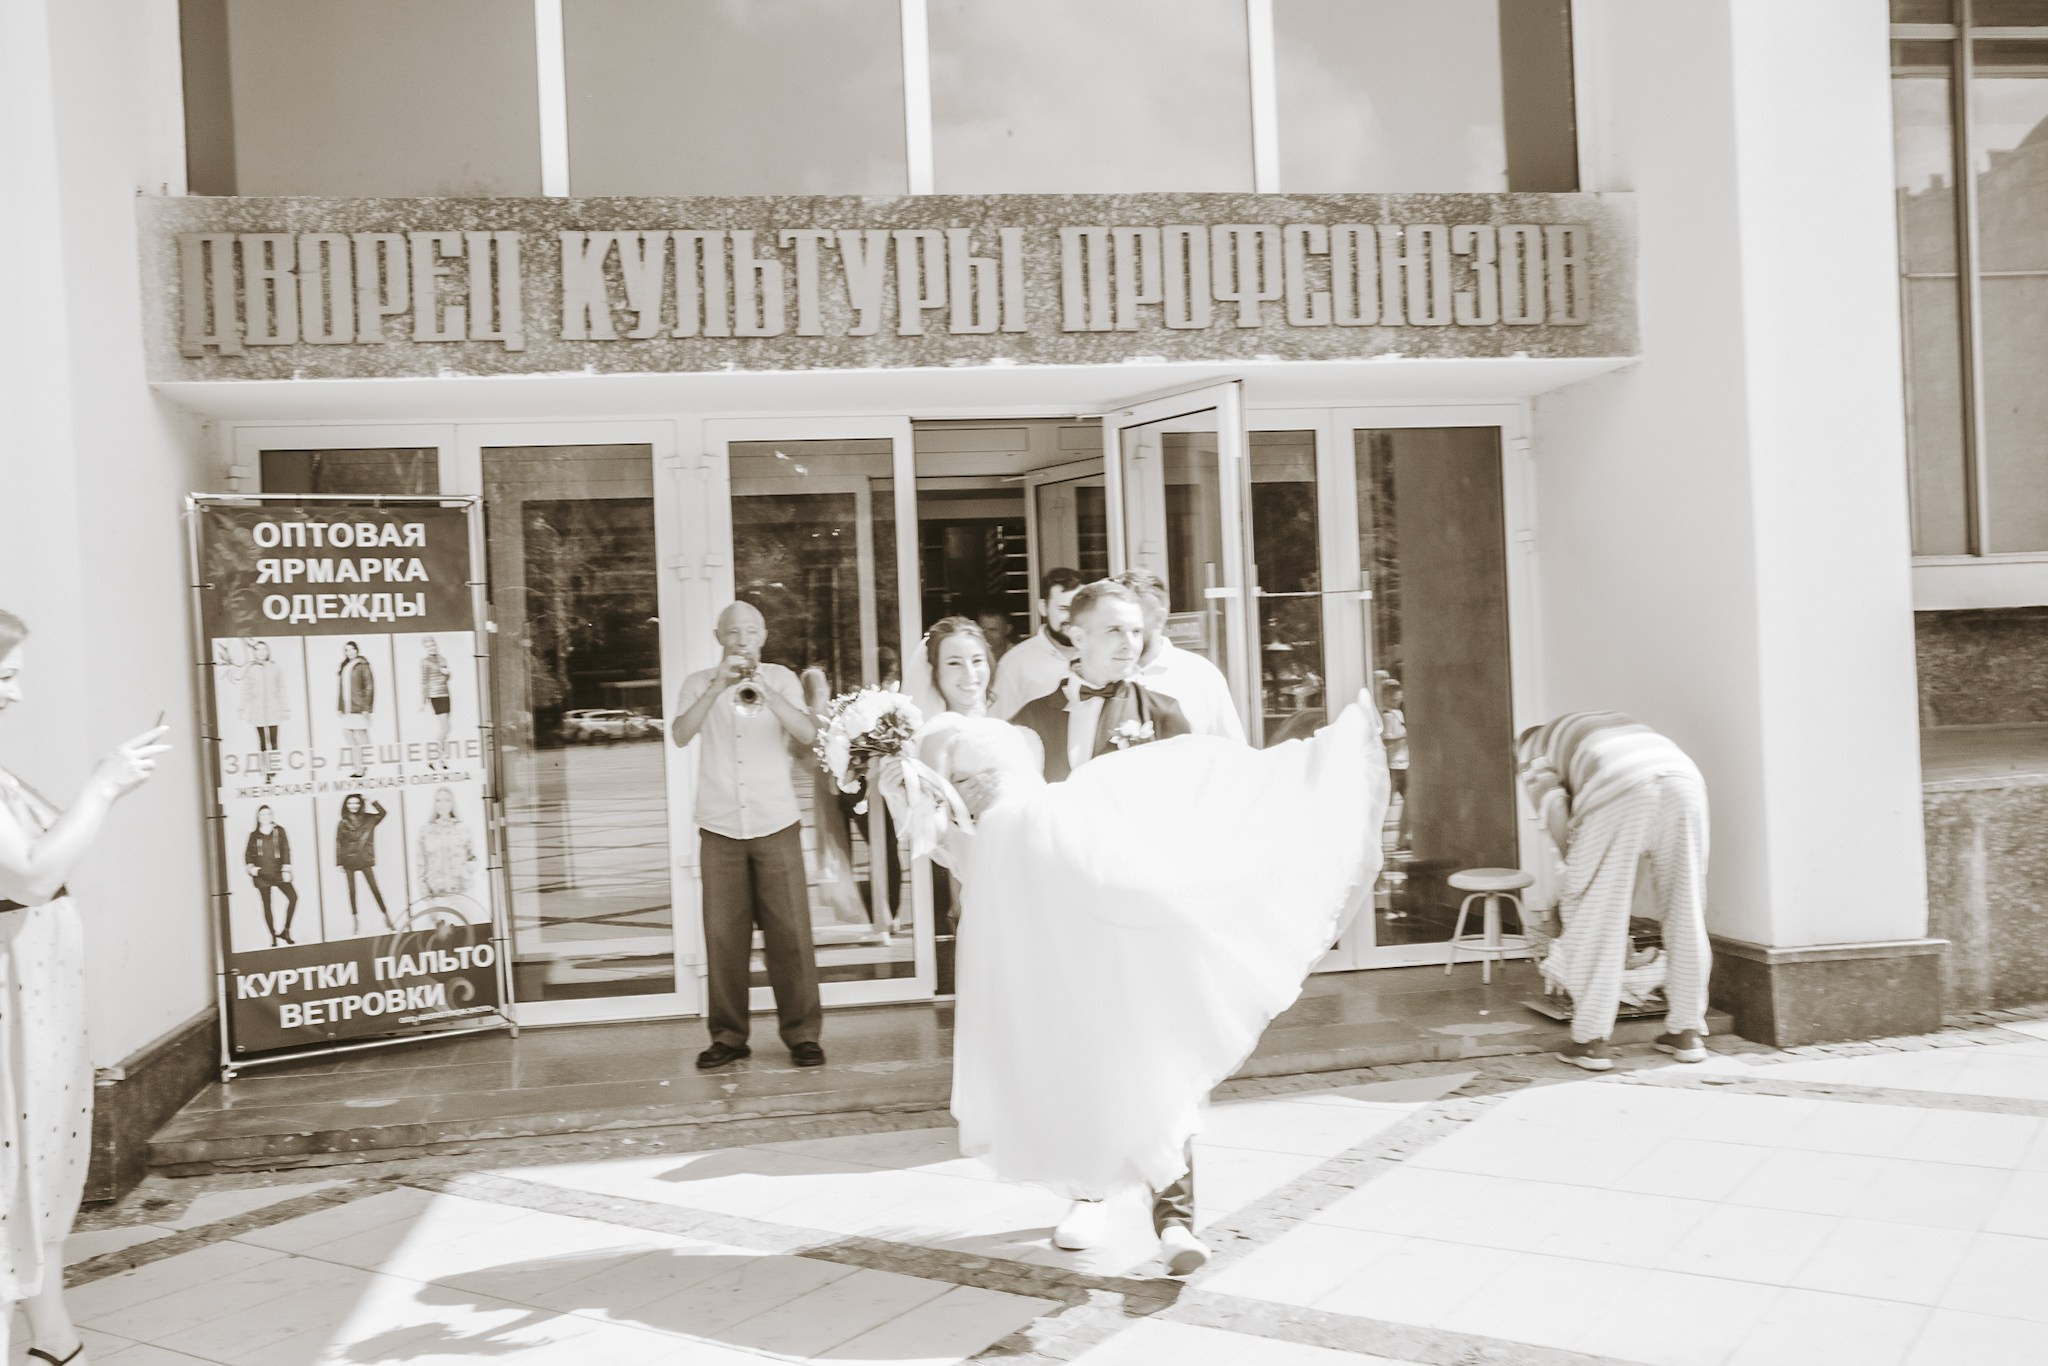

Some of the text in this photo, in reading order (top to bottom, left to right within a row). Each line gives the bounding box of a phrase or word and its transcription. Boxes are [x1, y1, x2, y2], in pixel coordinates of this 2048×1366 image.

[178, 223, 1593, 358] ДВОРЕЦ КУЛЬТУРЫ ПРОФСОЮЗОВ
[253, 522, 426, 548] ОПТОВАЯ
[256, 558, 429, 584] ЯРМАРКА
[262, 593, 426, 624] ОДЕЖДЫ
[224, 739, 481, 777] ЗДЕСЬ ДЕШЕВЛЕ
[236, 944, 494, 1000] КУРТКИ ПАЛЬТО
[280, 983, 445, 1029] ВЕТРОВКИ
